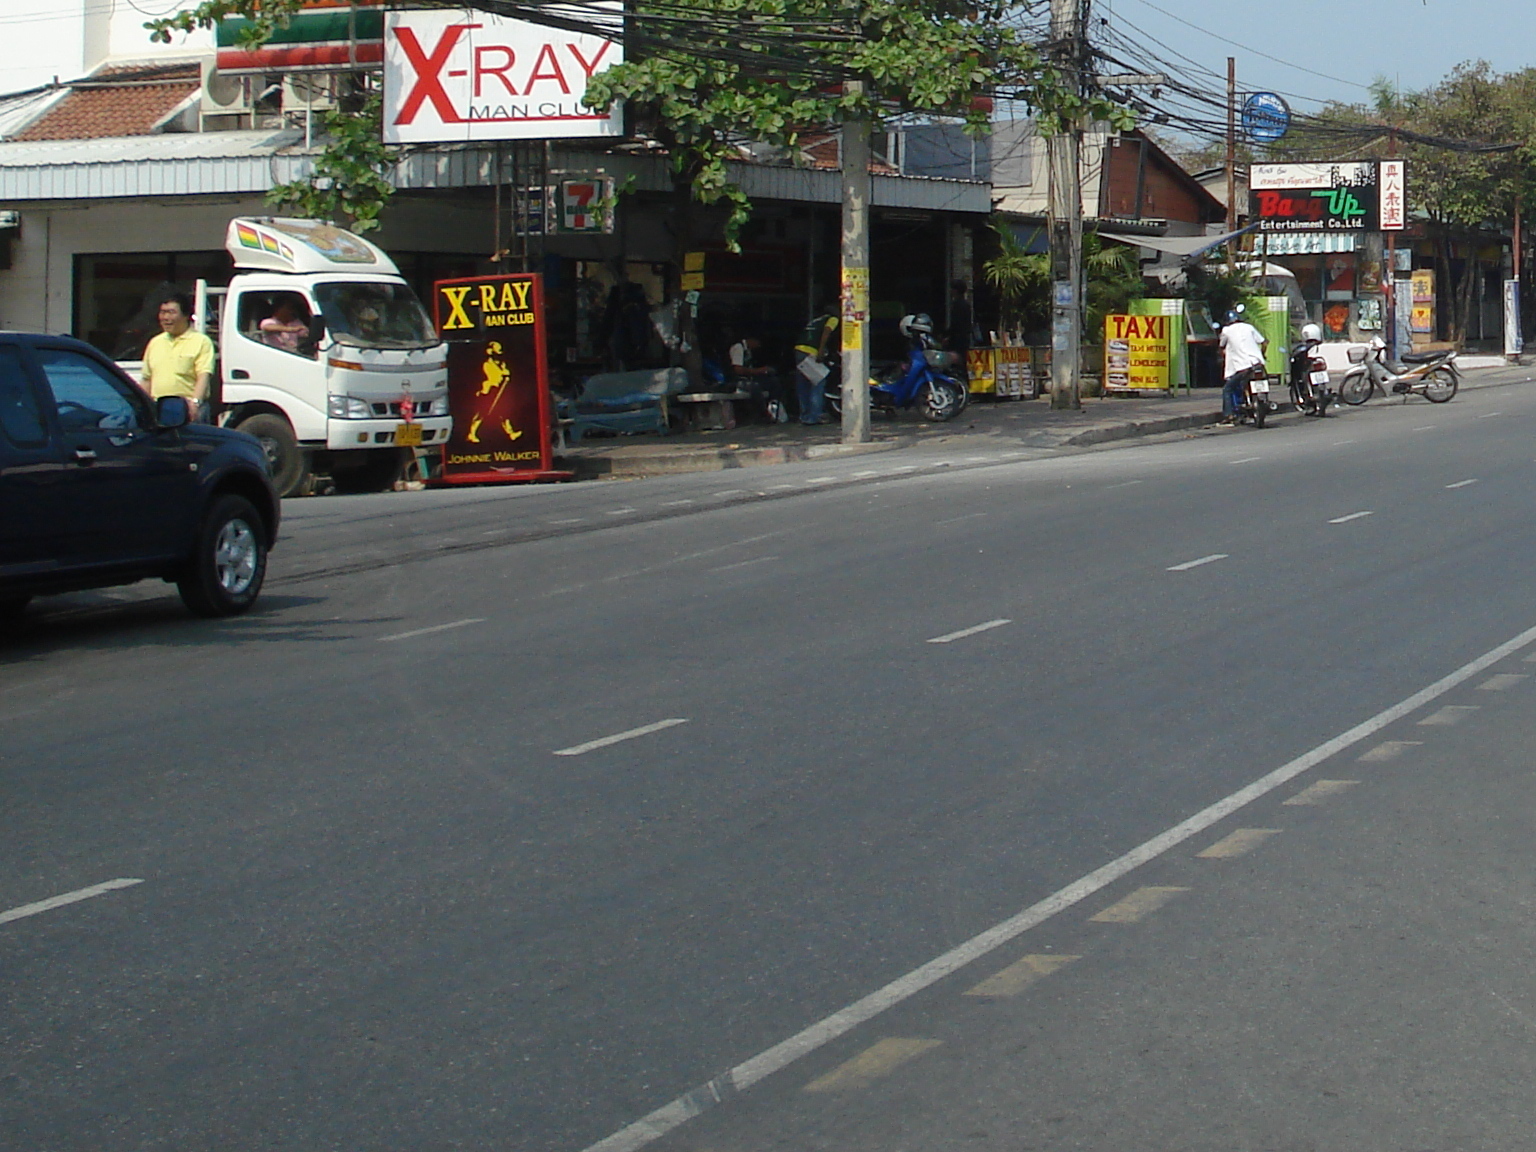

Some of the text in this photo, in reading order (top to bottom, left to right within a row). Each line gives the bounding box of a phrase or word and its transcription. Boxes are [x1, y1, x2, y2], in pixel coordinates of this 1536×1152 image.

[392, 24, 612, 126] X-RAY
[469, 104, 529, 119] MAN
[1256, 191, 1325, 221] Bang
[1311, 187, 1367, 220] Up
[1260, 218, 1325, 230] Entertainment
[440, 281, 533, 330] X-RAY
[507, 312, 535, 326] CLUB
[1112, 316, 1165, 339] TAXI
[447, 452, 492, 465] JOHNNIE
